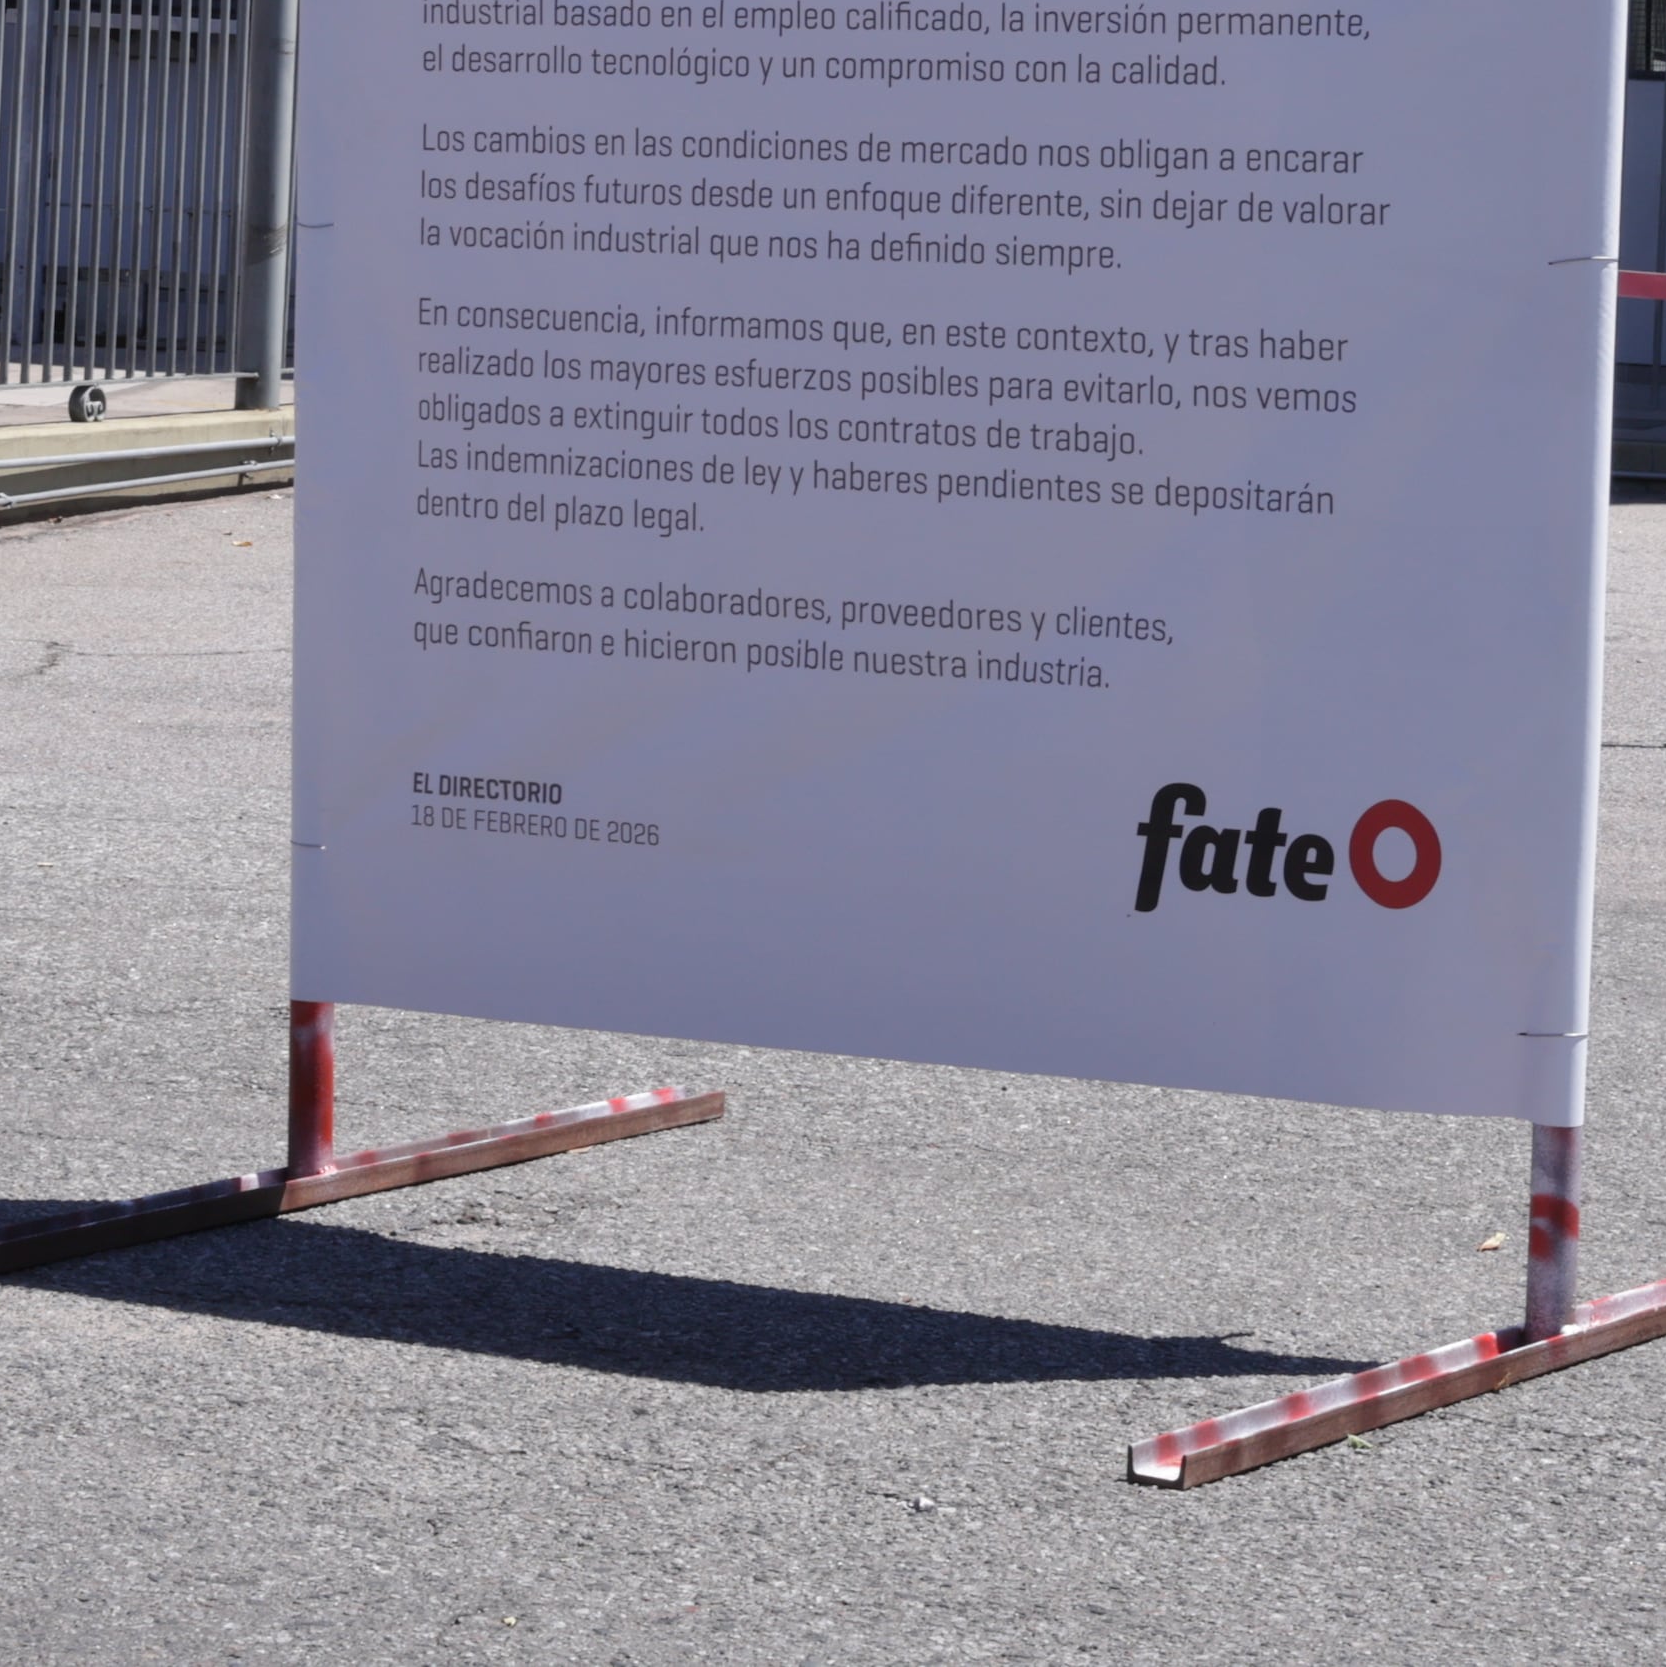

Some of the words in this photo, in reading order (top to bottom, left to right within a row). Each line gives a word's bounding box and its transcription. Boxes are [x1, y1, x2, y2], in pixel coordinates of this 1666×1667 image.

[661, 6, 692, 28] en
[702, 0, 724, 29] el
[734, 0, 835, 37] empleo
[846, 0, 990, 35] calificado,
[1001, 2, 1024, 33] la
[1035, 2, 1166, 35] inversión
[1177, 9, 1370, 43] permanente,
[423, 43, 442, 72] el
[452, 43, 582, 75] desarrollo
[591, 47, 750, 85] tecnológico
[759, 56, 774, 86] y
[782, 57, 815, 79] un
[825, 51, 1005, 88] compromiso
[1015, 60, 1066, 83] con
[1077, 53, 1101, 84] la
[1112, 54, 1225, 86] calidad.
[422, 123, 465, 152] Los
[474, 125, 586, 155] cambios
[595, 134, 625, 156] en
[635, 127, 673, 157] las
[682, 129, 848, 162] condiciones
[858, 133, 891, 163] de
[901, 135, 1027, 166] mercado
[1038, 144, 1090, 168] nos
[1100, 138, 1208, 178] obligan
[1219, 148, 1235, 171] a
[1246, 149, 1364, 174] encarar
[421, 170, 457, 199] los
[465, 171, 575, 203] desafíos
[584, 174, 682, 206] futuros
[691, 177, 773, 209] desde
[783, 188, 816, 210] un
[826, 181, 941, 221] enfoque
[951, 184, 1089, 221] diferente,
[1100, 188, 1142, 219] sin
[1153, 189, 1228, 229] dejar
[1238, 191, 1273, 223] de
[1282, 193, 1391, 226] valorar
[420, 217, 440, 246] la
[449, 221, 564, 250] vocación
[573, 222, 699, 255] industrial
[710, 234, 758, 263] que
[768, 236, 818, 259] nos
[827, 229, 860, 260] ha
[871, 231, 985, 265] definido
[996, 235, 1121, 276] siempre.
[419, 297, 447, 326] En
[457, 304, 645, 338] consecuencia,
[656, 306, 823, 342] informamos
[833, 320, 892, 351] que,
[902, 323, 935, 346] en
[946, 321, 1006, 349] este
[1017, 325, 1154, 358] contexto,
[1164, 333, 1180, 364] y
[1188, 329, 1249, 358] tras
[1260, 328, 1349, 362] haber
[419, 346, 534, 378] realizado
[544, 349, 581, 380] los
[590, 359, 706, 391] mayores
[715, 358, 851, 392] esfuerzos
[861, 365, 979, 401] posibles
[989, 376, 1053, 407] para
[1064, 372, 1181, 410] evitarlo,
[1193, 384, 1247, 409] nos
[1256, 387, 1357, 413] vemos
[419, 393, 541, 431] obligados
[549, 405, 564, 427] a
[574, 401, 694, 440] extinguir
[701, 407, 779, 438] todos
[789, 409, 828, 440] los
[838, 417, 976, 448] contratos
[987, 418, 1020, 450] de
[1030, 422, 1143, 462] trabajo.
[418, 440, 458, 470] Las
[467, 442, 693, 483] indemnizaciones
[702, 454, 734, 485] de
[745, 456, 782, 495] ley
[789, 466, 804, 496] y
[813, 459, 928, 495] haberes
[938, 468, 1101, 503] pendientes
[1111, 482, 1144, 506] se
[1155, 476, 1334, 516] depositarán
[417, 487, 498, 520] dentro
[507, 493, 545, 522] del
[555, 495, 623, 531] plazo
[634, 499, 704, 538] legal.
[414, 567, 592, 606] Agradecemos
[601, 586, 614, 608] a
[624, 581, 831, 624] colaboradores,
[841, 599, 1022, 632] proveedores
[1030, 612, 1046, 642] y
[1056, 605, 1173, 646] clientes,
[414, 621, 458, 651] que
[468, 620, 592, 654] confiaron
[601, 634, 614, 656] e
[624, 628, 736, 663] hicieron
[747, 639, 844, 673] posible
[854, 650, 967, 678] nuestra
[977, 650, 1109, 688] industria.
[413, 771, 434, 795] EL
[438, 774, 562, 805] DIRECTORIO
[412, 804, 434, 827] 18
[442, 807, 466, 830] DE
[474, 809, 567, 838] FEBRERO
[575, 818, 600, 841] DE
[607, 820, 659, 846] 2026
[1135, 781, 1335, 912] fate
